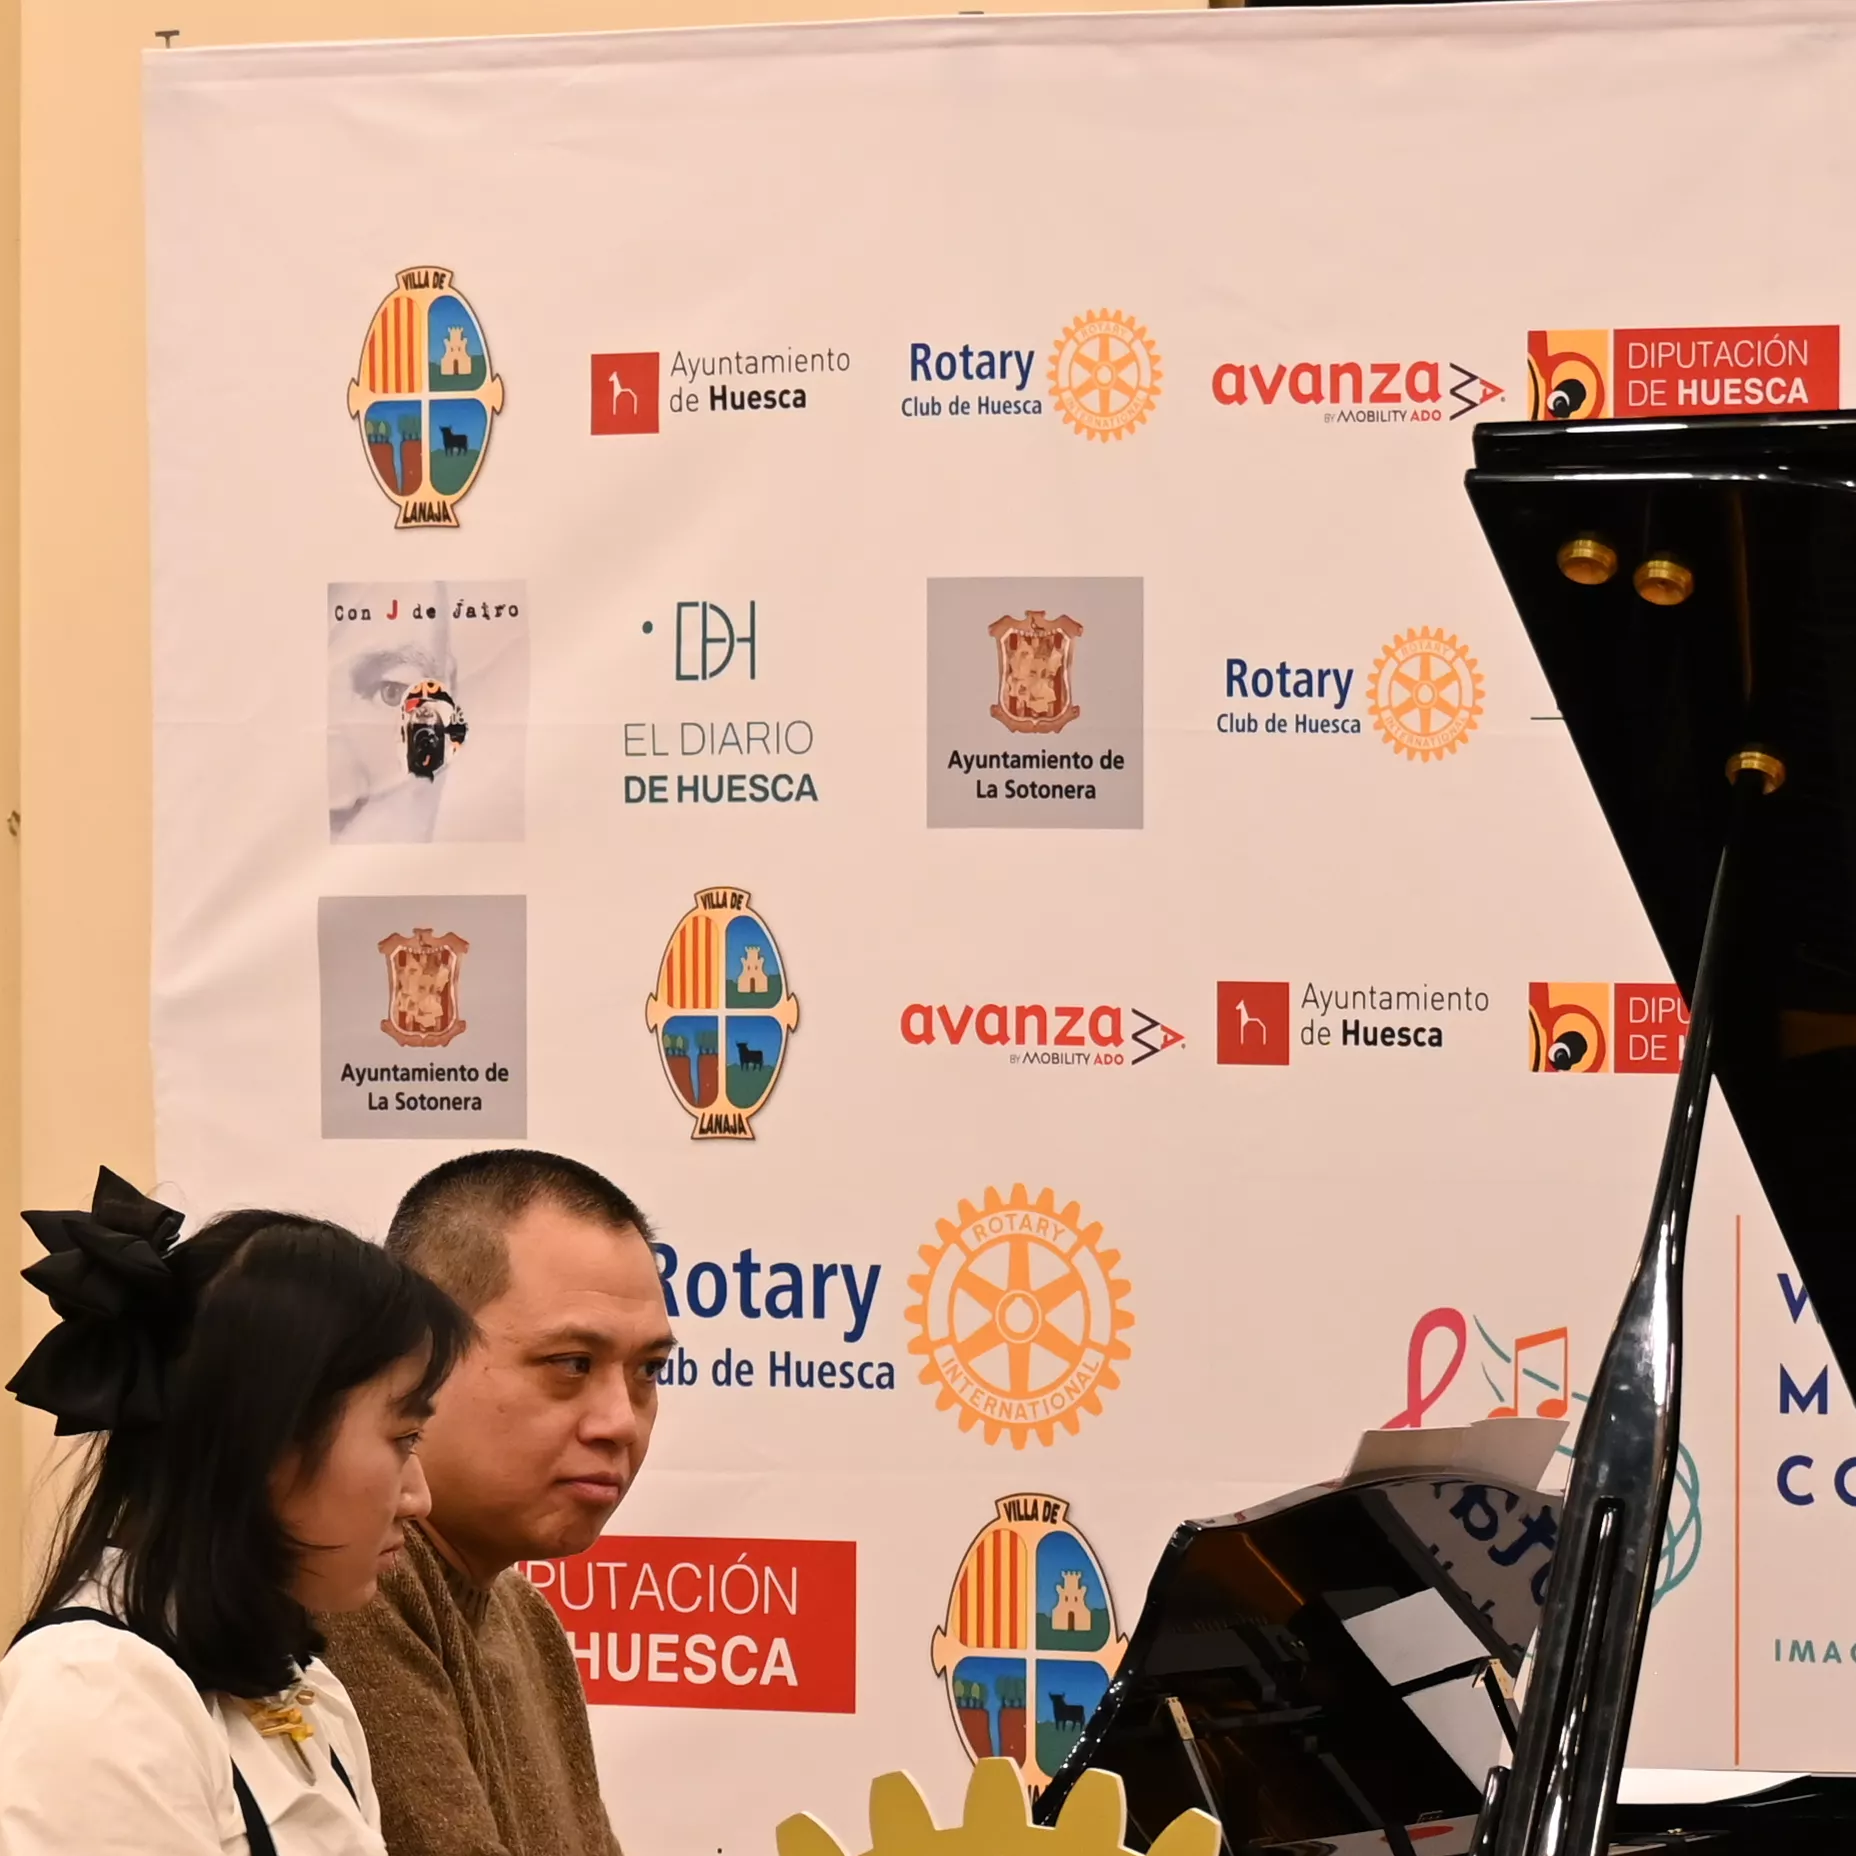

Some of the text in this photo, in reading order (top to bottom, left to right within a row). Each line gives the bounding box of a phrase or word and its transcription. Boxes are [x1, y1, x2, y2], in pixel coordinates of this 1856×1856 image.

[402, 271, 446, 290] VILLA DE
[1080, 319, 1128, 338] ROTARY
[1629, 334, 1807, 368] DIPUTACIÓN
[671, 347, 850, 383] Ayuntamiento
[911, 343, 1034, 391] Rotary
[1212, 361, 1442, 405] avanza
[1629, 377, 1808, 406] DE HUESCA
[670, 385, 806, 412] de Huesca
[902, 395, 1041, 417] Club de Huesca
[1324, 409, 1441, 423] BY MOBILITY ADO
[402, 500, 452, 524] LANAJA
[335, 605, 371, 621] Con
[387, 600, 398, 620] J
[413, 604, 436, 619] de
[1399, 640, 1452, 658] ROTARY
[1227, 659, 1353, 709] Rotary
[1217, 713, 1360, 733] Club de Huesca
[624, 720, 813, 756] EL DIARIO
[948, 749, 1124, 774] Ayuntamiento de
[625, 774, 818, 803] DE HUESCA
[977, 779, 1096, 799] La Sotonera
[700, 893, 746, 912] VILLA DE
[1301, 982, 1488, 1016] Ayuntamiento
[901, 1004, 1124, 1047] avanza
[1301, 1019, 1442, 1047] de Huesca
[1010, 1052, 1124, 1065] BY MOBILITY ADO
[1630, 1035, 1667, 1060] DE
[341, 1062, 508, 1086] Ayuntamiento de
[369, 1092, 481, 1110] La Sotonera
[699, 1114, 748, 1137] LANAJA
[972, 1214, 1067, 1241] ROTARY
[655, 1243, 882, 1343] Rotary
[656, 1347, 894, 1389] ub de Huesca
[942, 1356, 1102, 1421] INTERNATIONAL
[1004, 1502, 1060, 1525] VILLA DE
[520, 1552, 797, 1615] PUTACIÓN
[568, 1631, 798, 1687] HUESCA
